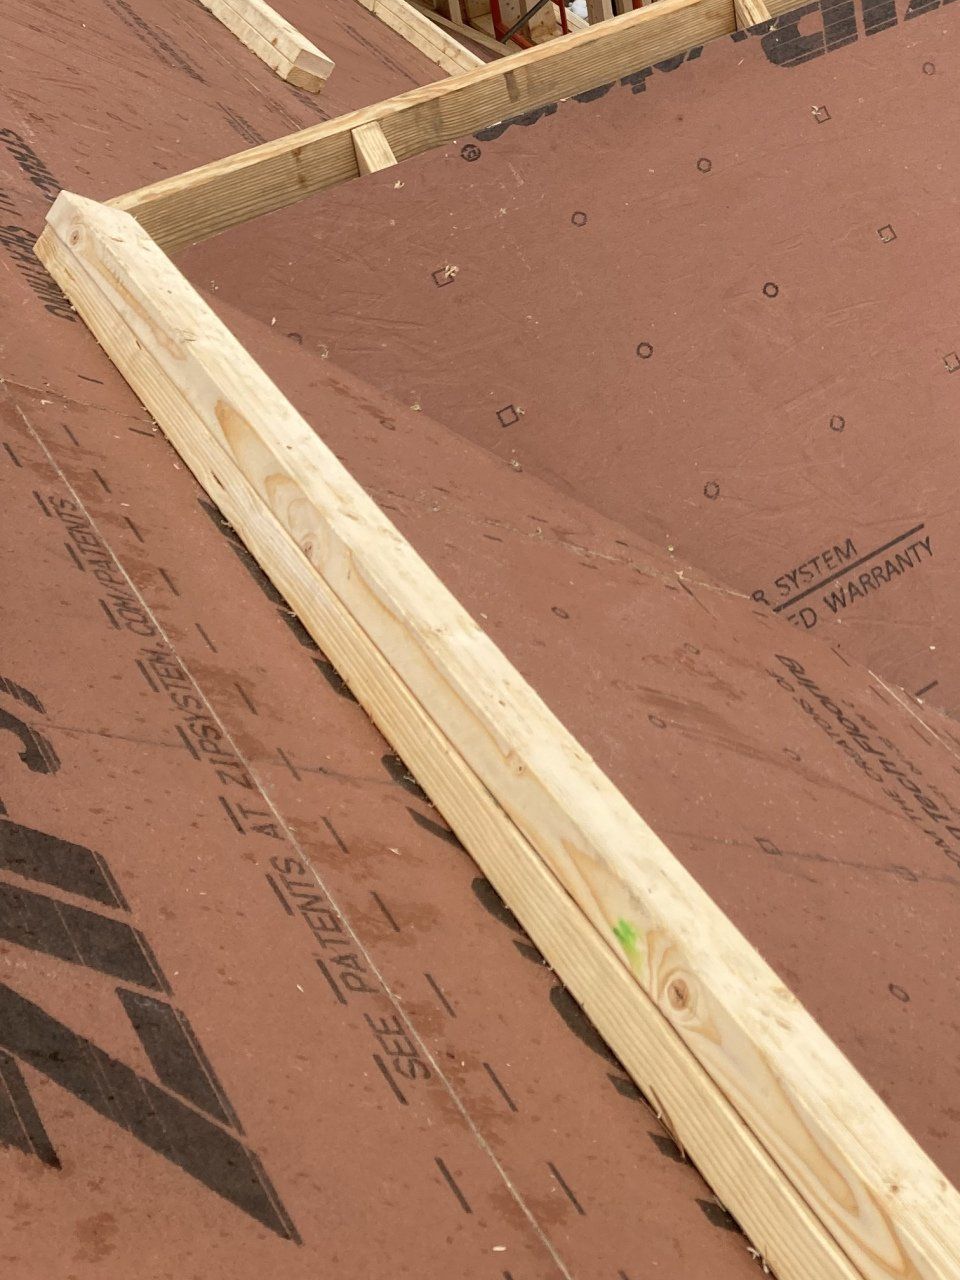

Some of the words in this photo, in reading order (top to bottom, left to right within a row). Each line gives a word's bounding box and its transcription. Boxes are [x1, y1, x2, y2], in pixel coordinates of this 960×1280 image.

[773, 537, 858, 596] SYSTEM
[823, 535, 935, 615] WARRANTY
[768, 669, 796, 693] OF
[792, 696, 884, 784] CREATORS
[243, 798, 283, 841] AT
[285, 855, 378, 995] PATENTS
[367, 1013, 432, 1080] SEE
